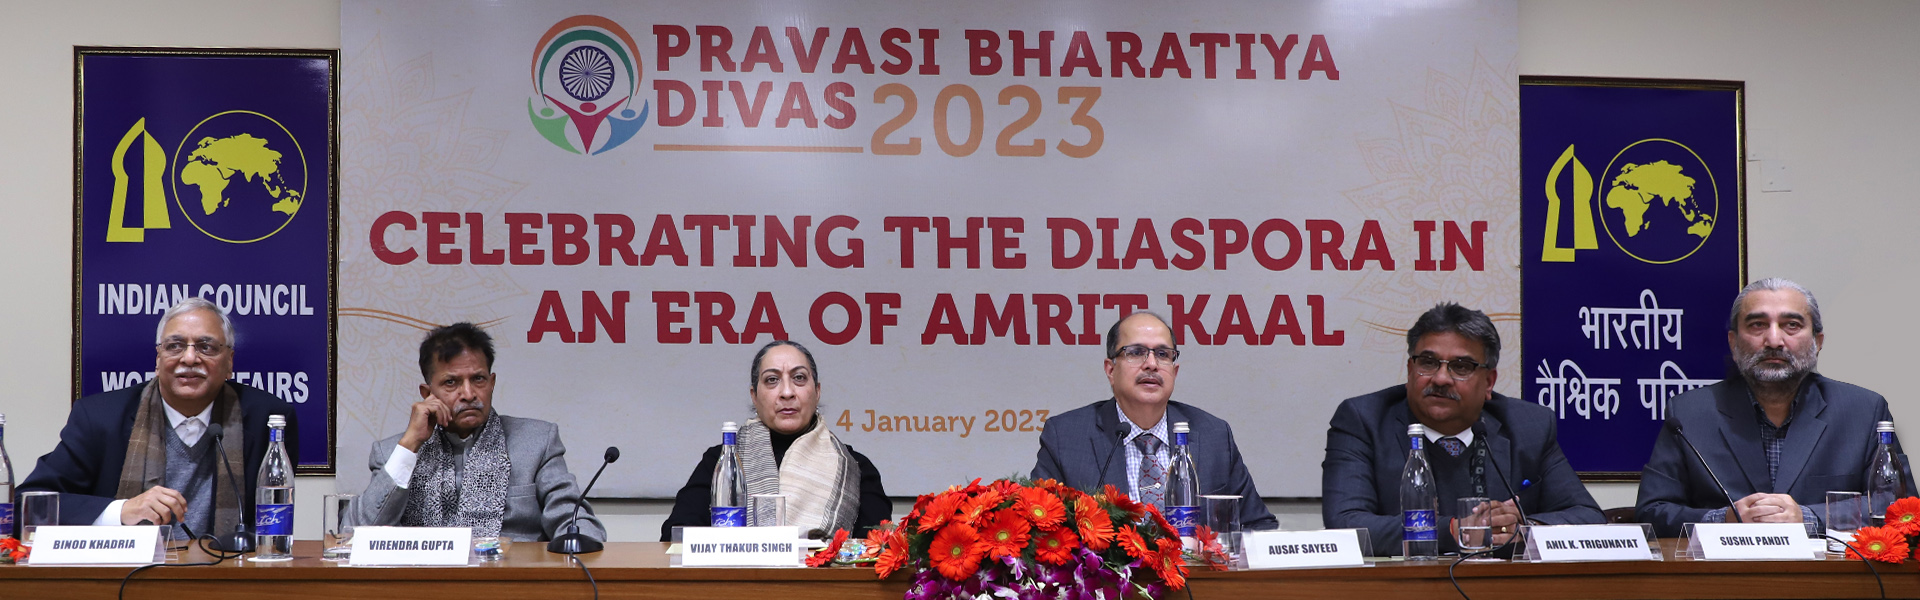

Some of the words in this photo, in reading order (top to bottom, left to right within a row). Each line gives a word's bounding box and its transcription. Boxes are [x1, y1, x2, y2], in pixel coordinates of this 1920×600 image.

[654, 25, 939, 75] PRAVASI
[966, 30, 1339, 80] BHARATIYA
[654, 80, 856, 129] DIVAS
[871, 84, 1104, 158] 2023
[370, 211, 865, 268] CELEBRATING
[884, 217, 1026, 268] THE
[1047, 218, 1395, 271] DIASPORA
[1414, 221, 1488, 271] IN
[528, 291, 629, 343] AN
[653, 291, 788, 344] ERA
[810, 292, 901, 345] OF
[921, 293, 1149, 345] AMRIT
[1167, 294, 1345, 346] KAAL
[1578, 289, 1684, 350] भारतीय
[1535, 358, 1621, 420] वैश्विक
[836, 409, 853, 432] 4
[861, 409, 976, 438] January
[984, 409, 1049, 432] 2023
[53, 540, 87, 550] BINOD
[89, 539, 136, 549] KHADRIA
[369, 540, 419, 551] VIRENDRA
[421, 540, 454, 551] GUPTA
[690, 543, 717, 553] VIJAY
[719, 543, 759, 553] THAKUR
[761, 543, 793, 553] SINGH
[1268, 544, 1300, 555] AUSAF
[1301, 543, 1338, 554] SAYEED
[1545, 540, 1568, 550] ANIL
[1568, 540, 1579, 550] K.
[1578, 538, 1639, 549] TRIGUNAYAT
[1719, 536, 1755, 546] SUSHIL
[1755, 536, 1790, 546] PANDIT
